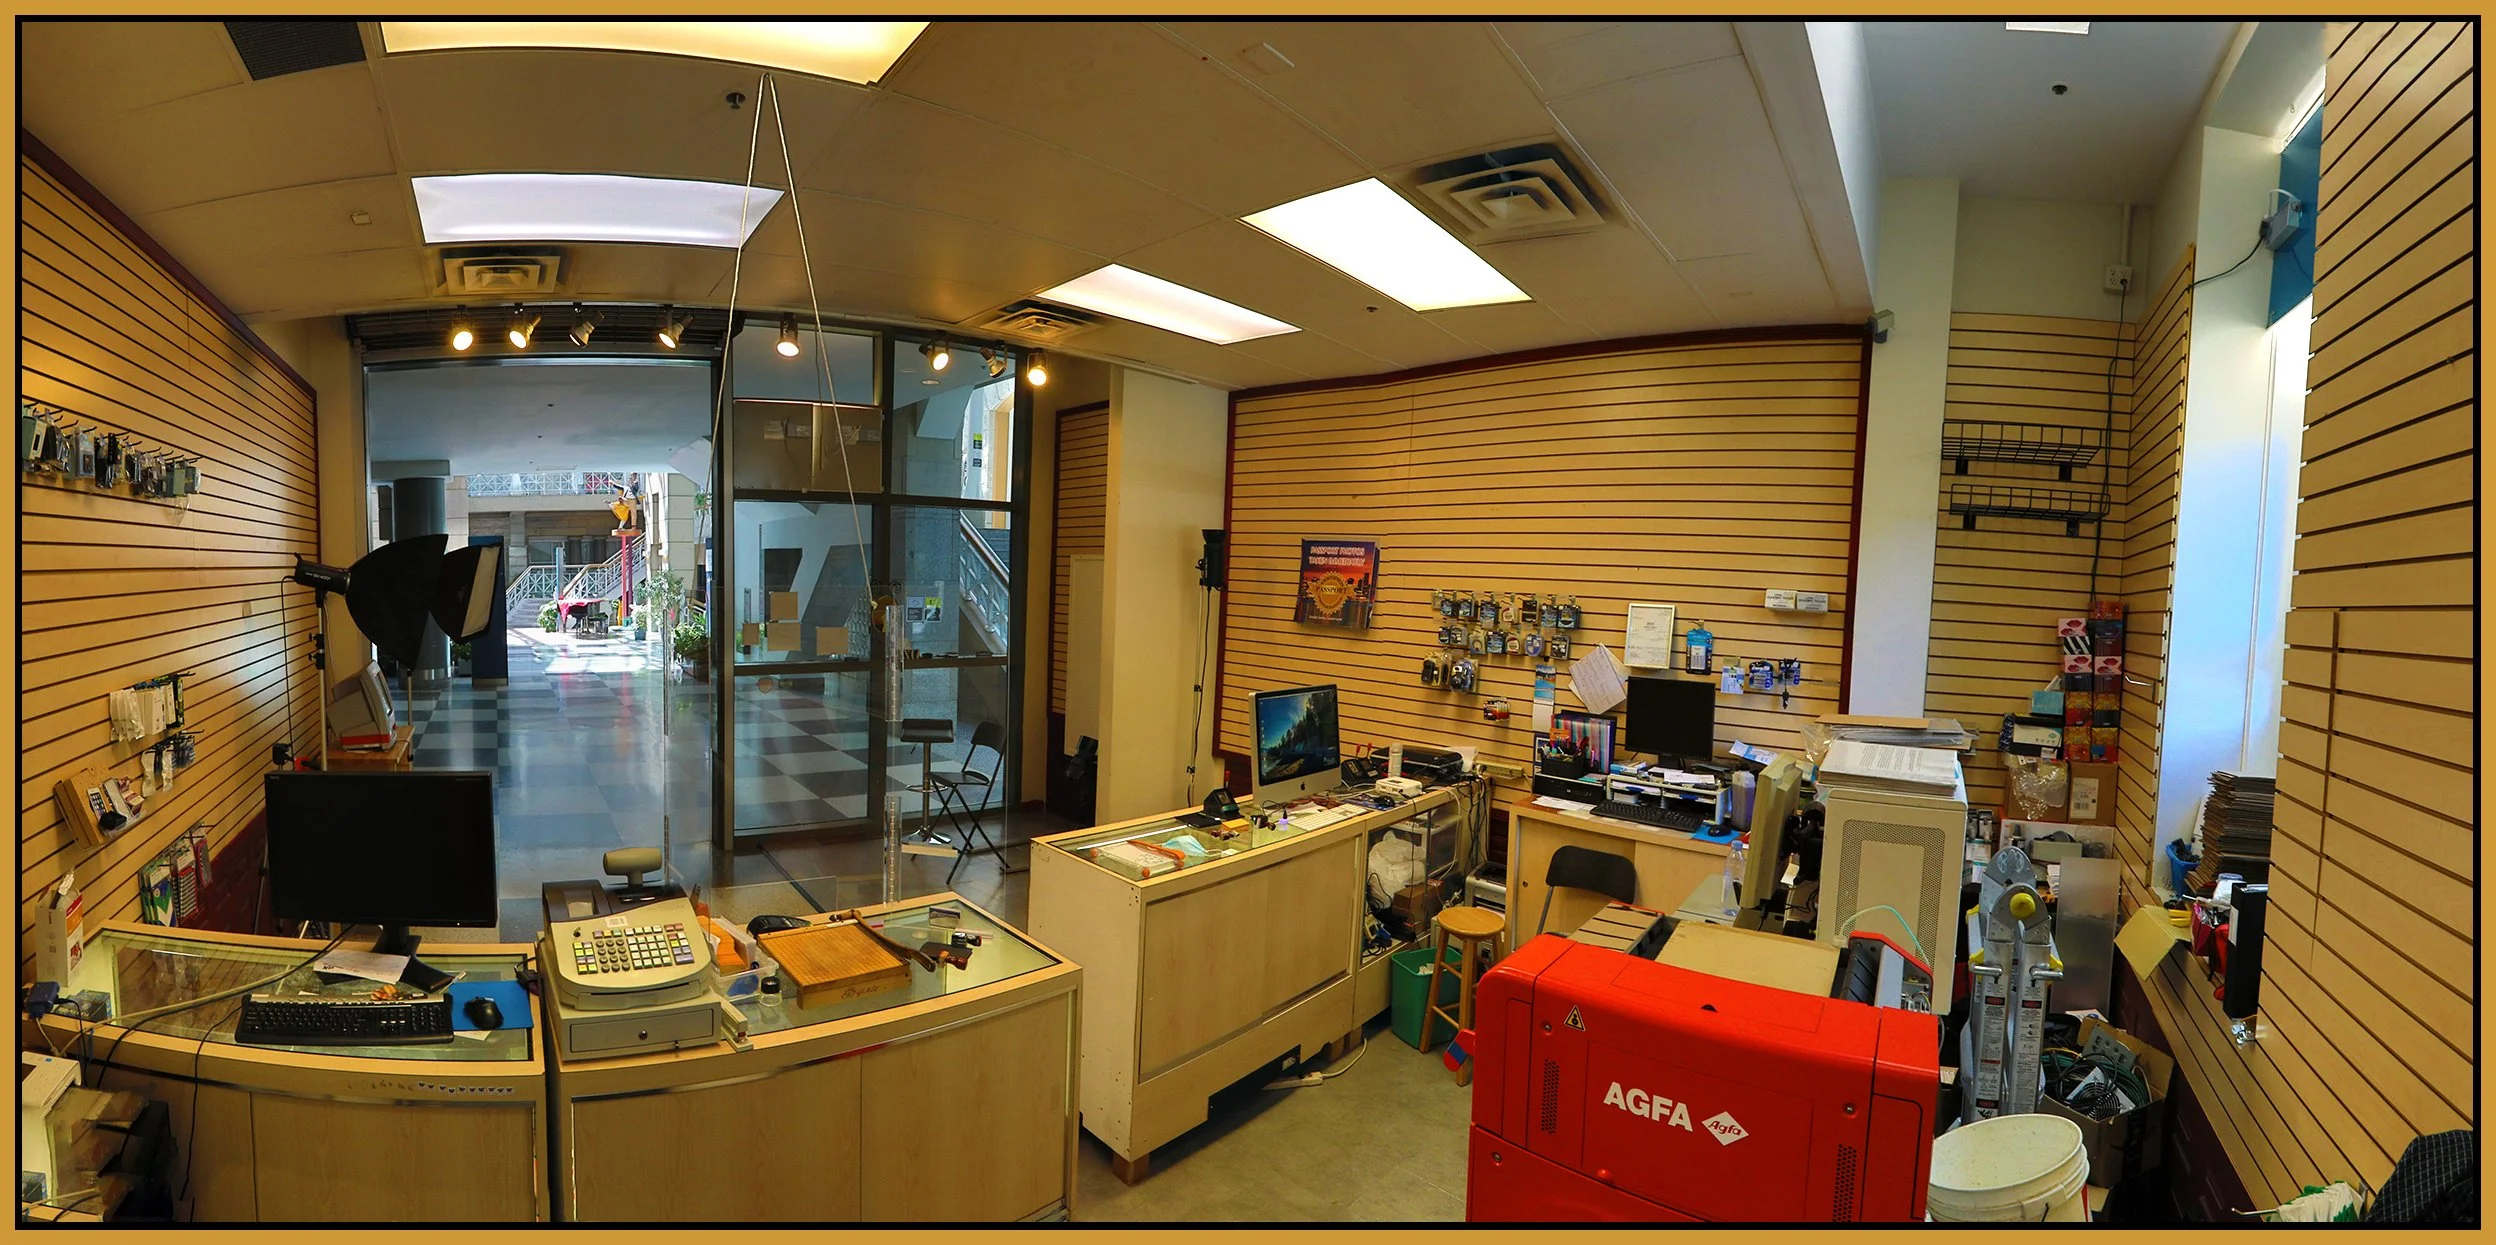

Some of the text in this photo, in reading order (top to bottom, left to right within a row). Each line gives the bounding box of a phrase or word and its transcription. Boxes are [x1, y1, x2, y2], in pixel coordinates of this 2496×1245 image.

[1310, 546, 1339, 554] PASSPORT
[1315, 585, 1347, 593] PASSPORT
[1603, 1081, 1693, 1132] AGFA
[1708, 1120, 1742, 1136] Agfa
